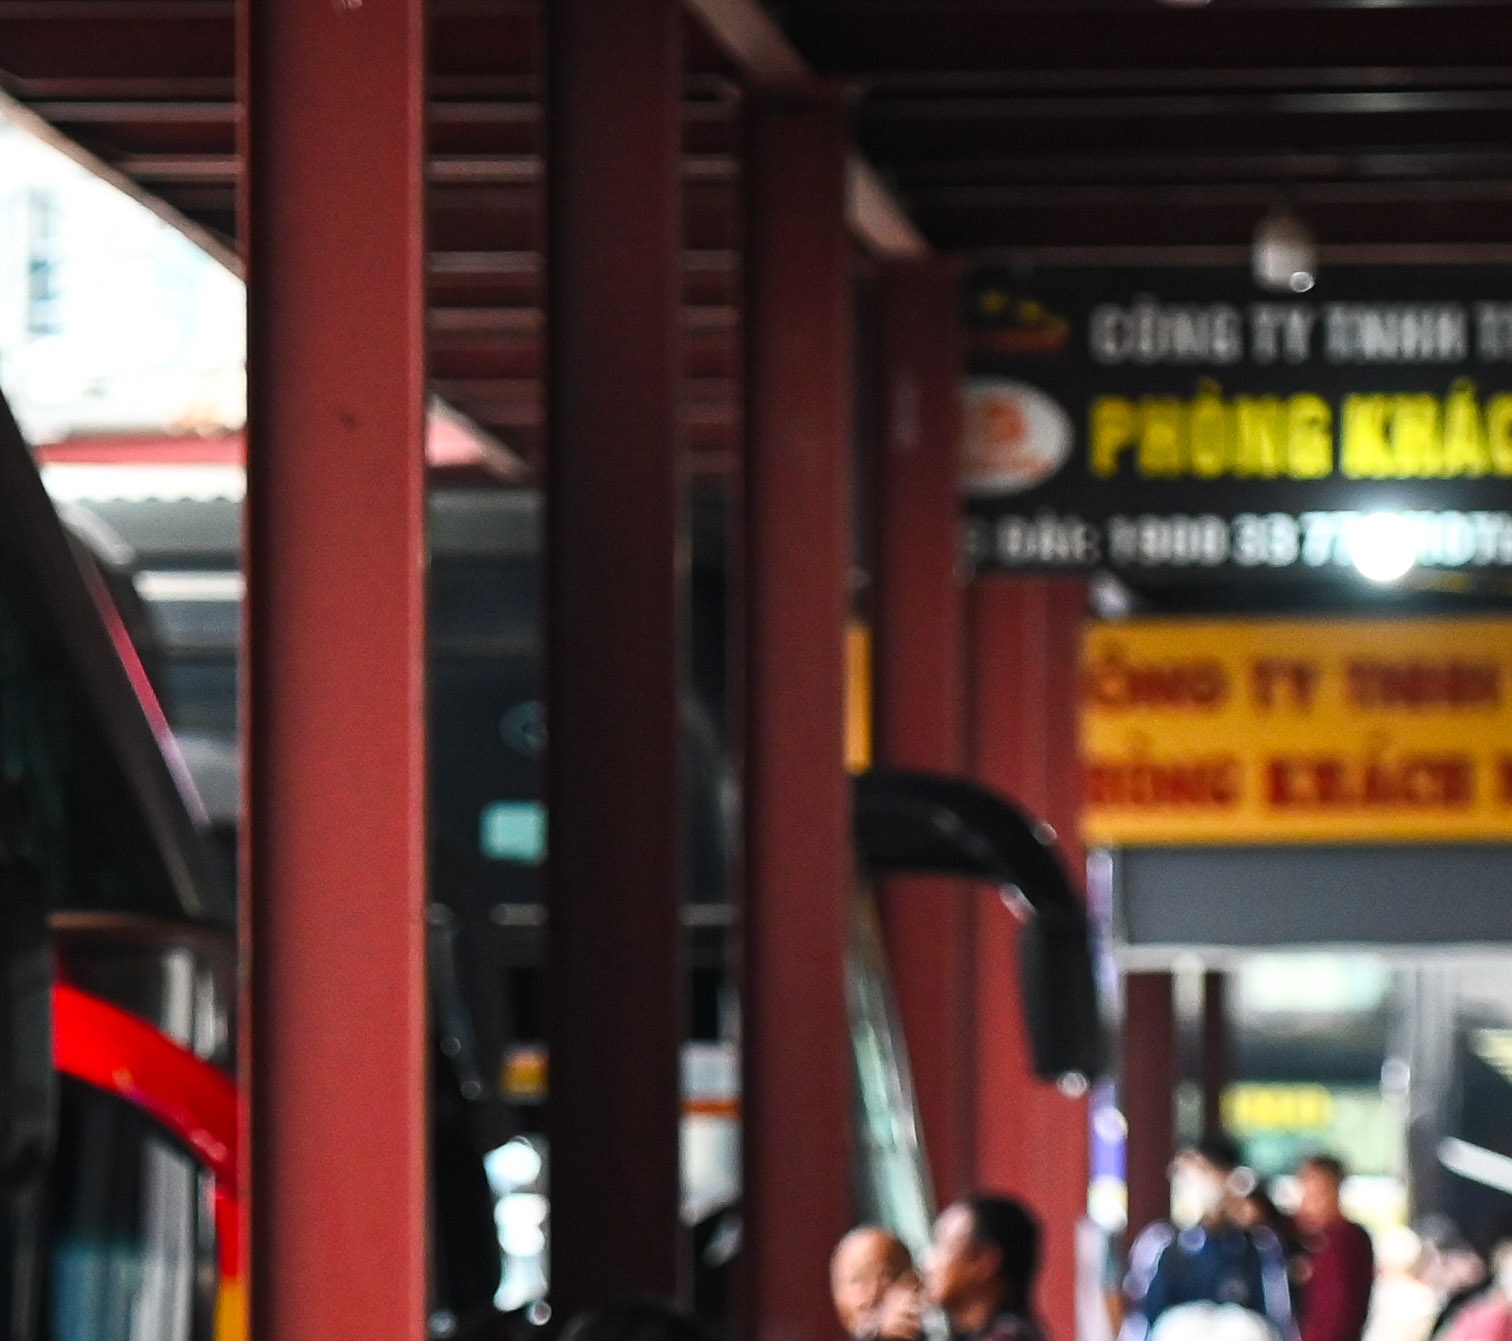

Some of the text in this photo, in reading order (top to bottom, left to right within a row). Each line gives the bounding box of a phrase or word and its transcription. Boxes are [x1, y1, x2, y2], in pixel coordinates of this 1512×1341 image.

[1090, 297, 1241, 362] CÔNG
[1252, 304, 1314, 362] TY
[1325, 304, 1466, 362] TNHH
[1090, 379, 1331, 479] PHÒNG
